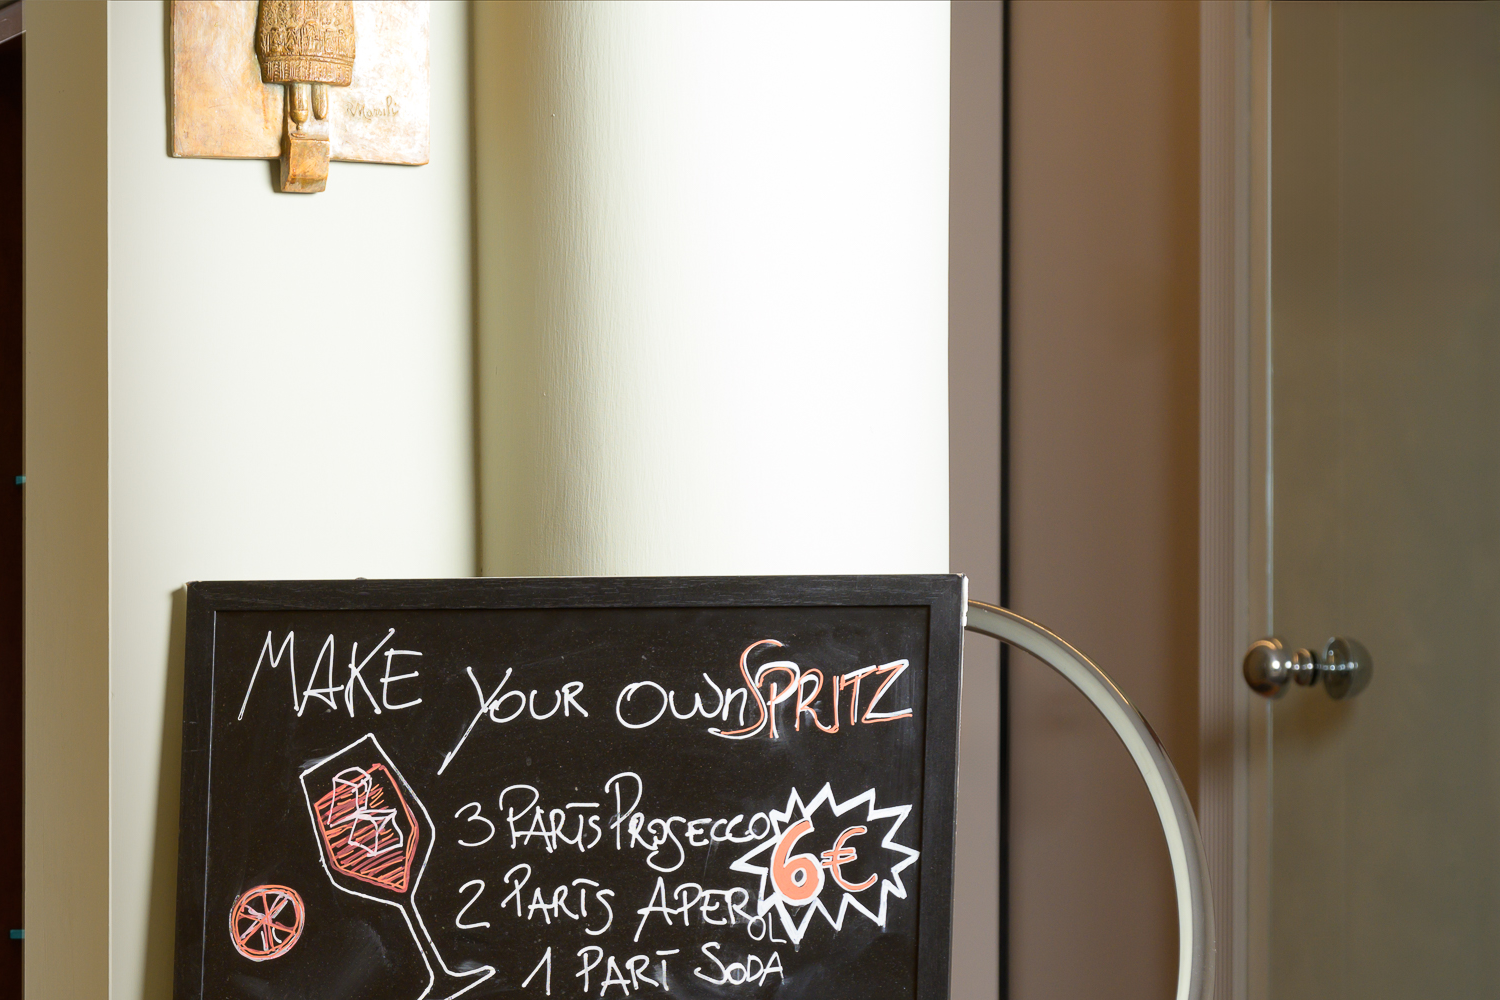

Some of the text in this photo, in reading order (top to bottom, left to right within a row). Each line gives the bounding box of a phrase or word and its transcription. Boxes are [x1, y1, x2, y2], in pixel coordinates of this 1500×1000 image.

[237, 628, 424, 721] MAKE
[437, 666, 590, 775] YOUR
[707, 638, 913, 739] SPRITZ
[454, 771, 771, 873] 3 PARTS PROSECCO
[770, 818, 879, 907] 6€
[455, 863, 788, 943] 2 PARTS APEROL
[521, 941, 785, 998] 1 PART SODA
